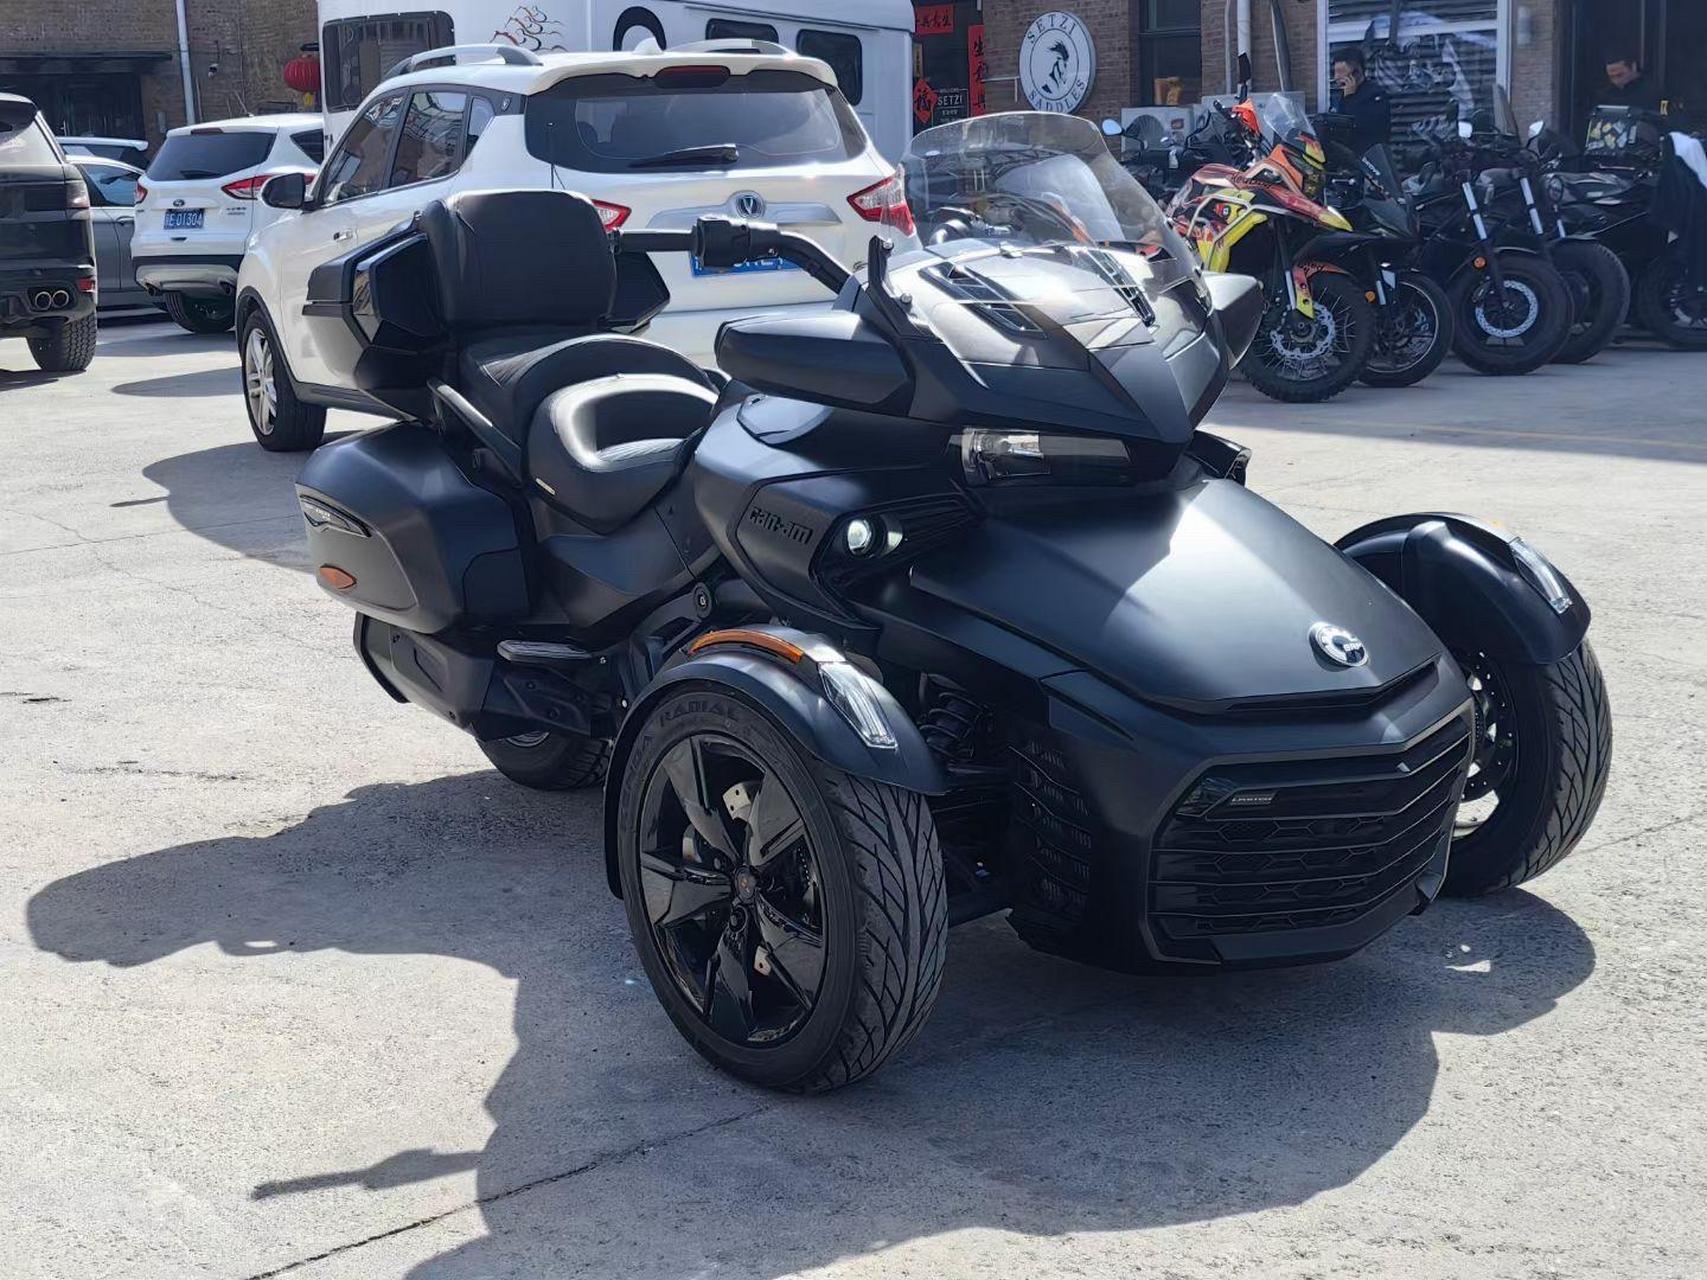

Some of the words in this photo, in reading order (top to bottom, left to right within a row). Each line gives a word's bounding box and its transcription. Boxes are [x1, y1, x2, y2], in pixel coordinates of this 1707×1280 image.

[1027, 14, 1076, 44] SETZI
[937, 94, 963, 106] SETZI
[1029, 79, 1084, 112] SADDLES
